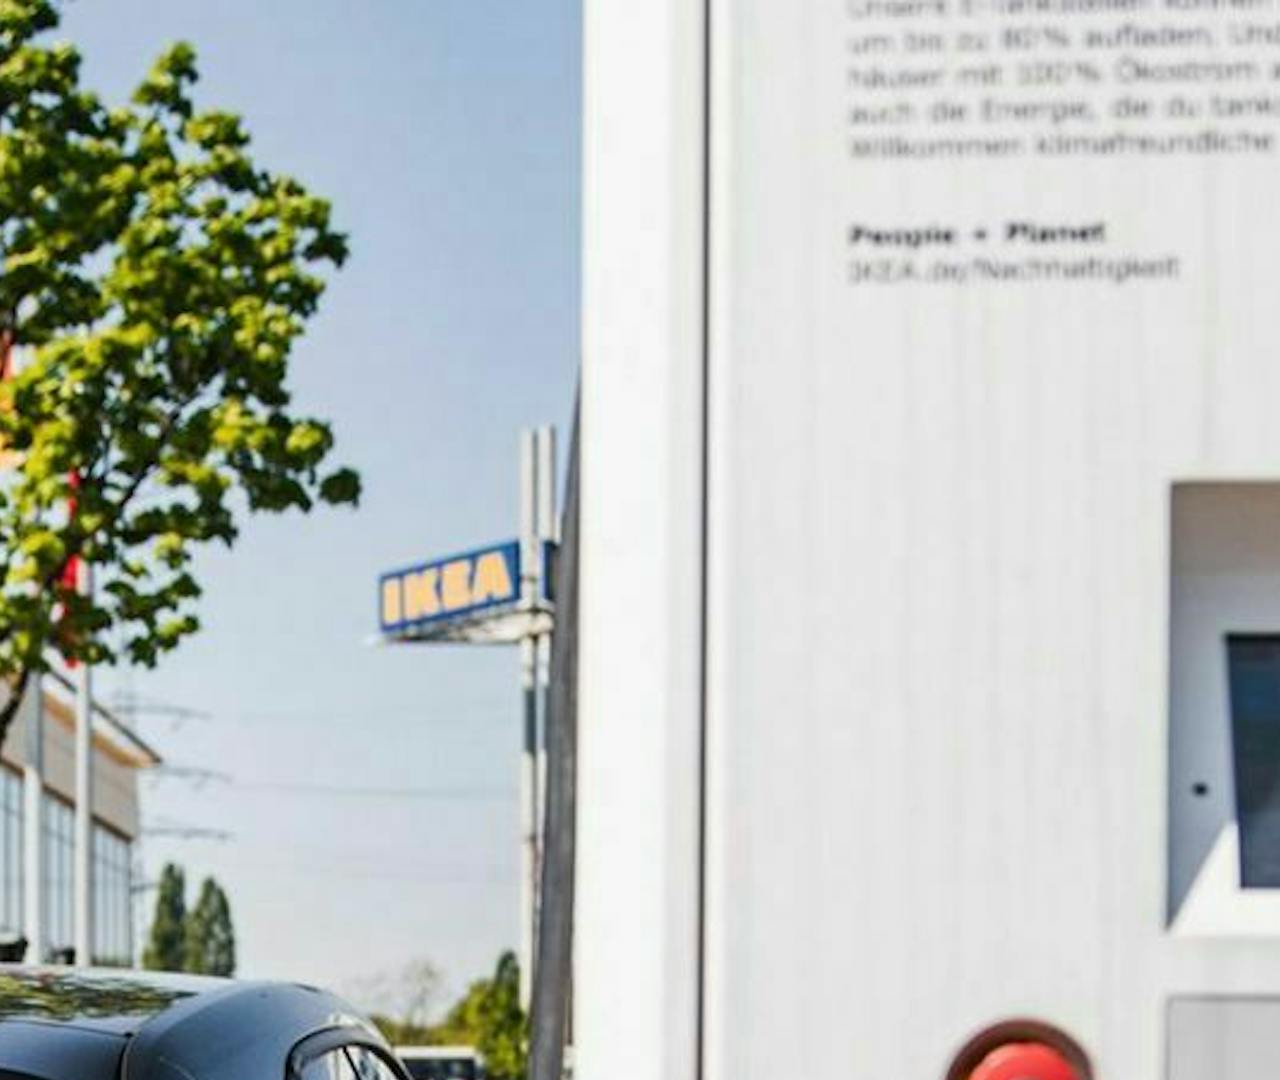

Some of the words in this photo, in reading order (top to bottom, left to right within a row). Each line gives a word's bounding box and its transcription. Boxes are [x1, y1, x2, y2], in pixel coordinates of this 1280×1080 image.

[849, 222, 954, 249] People
[1005, 221, 1106, 245] Planet
[382, 550, 513, 626] IKEA
